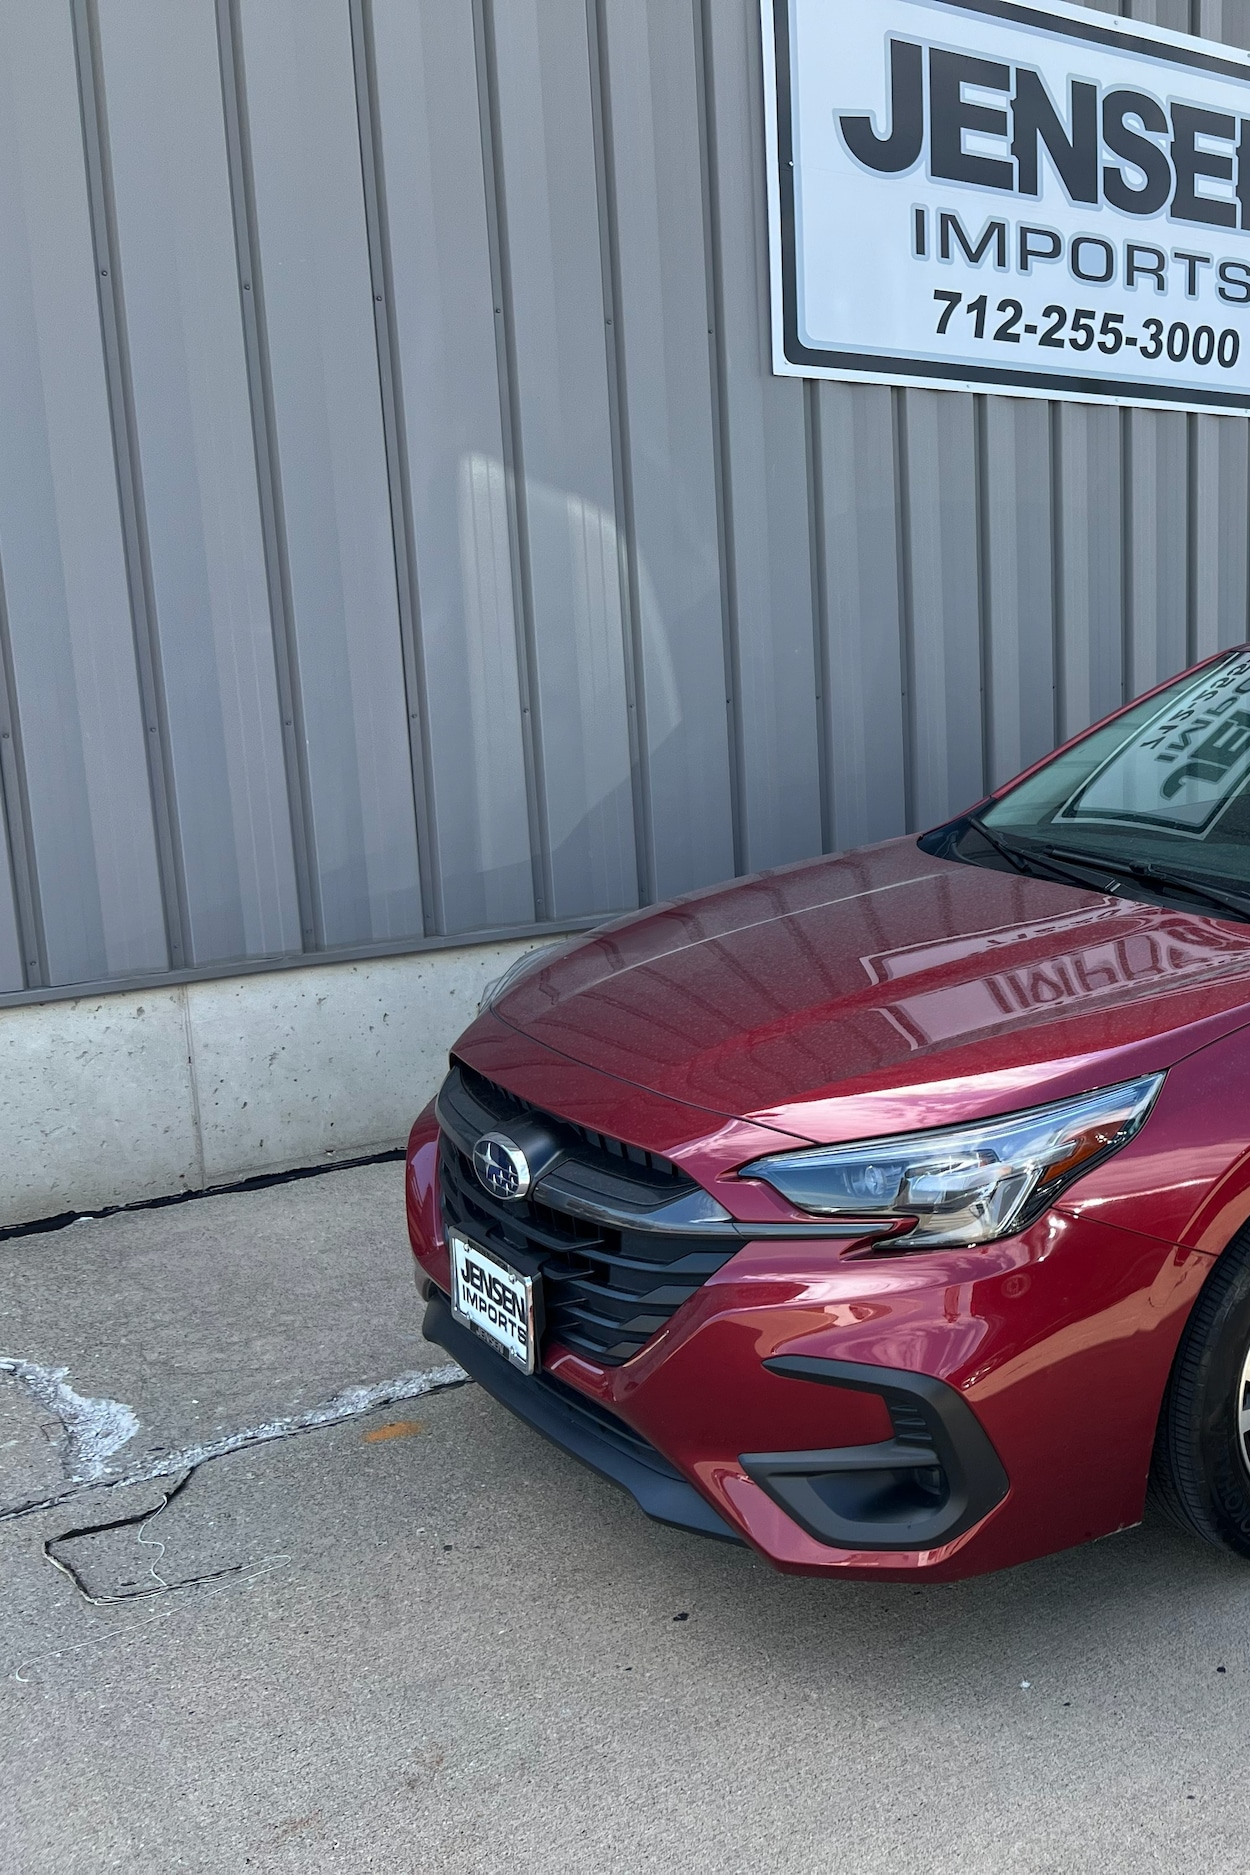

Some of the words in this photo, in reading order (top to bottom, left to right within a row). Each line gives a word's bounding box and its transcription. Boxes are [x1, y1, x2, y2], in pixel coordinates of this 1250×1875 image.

[932, 289, 1241, 369] 712-255-3000
[460, 1257, 526, 1323] JENSEN
[462, 1284, 528, 1345] IMPORTS
